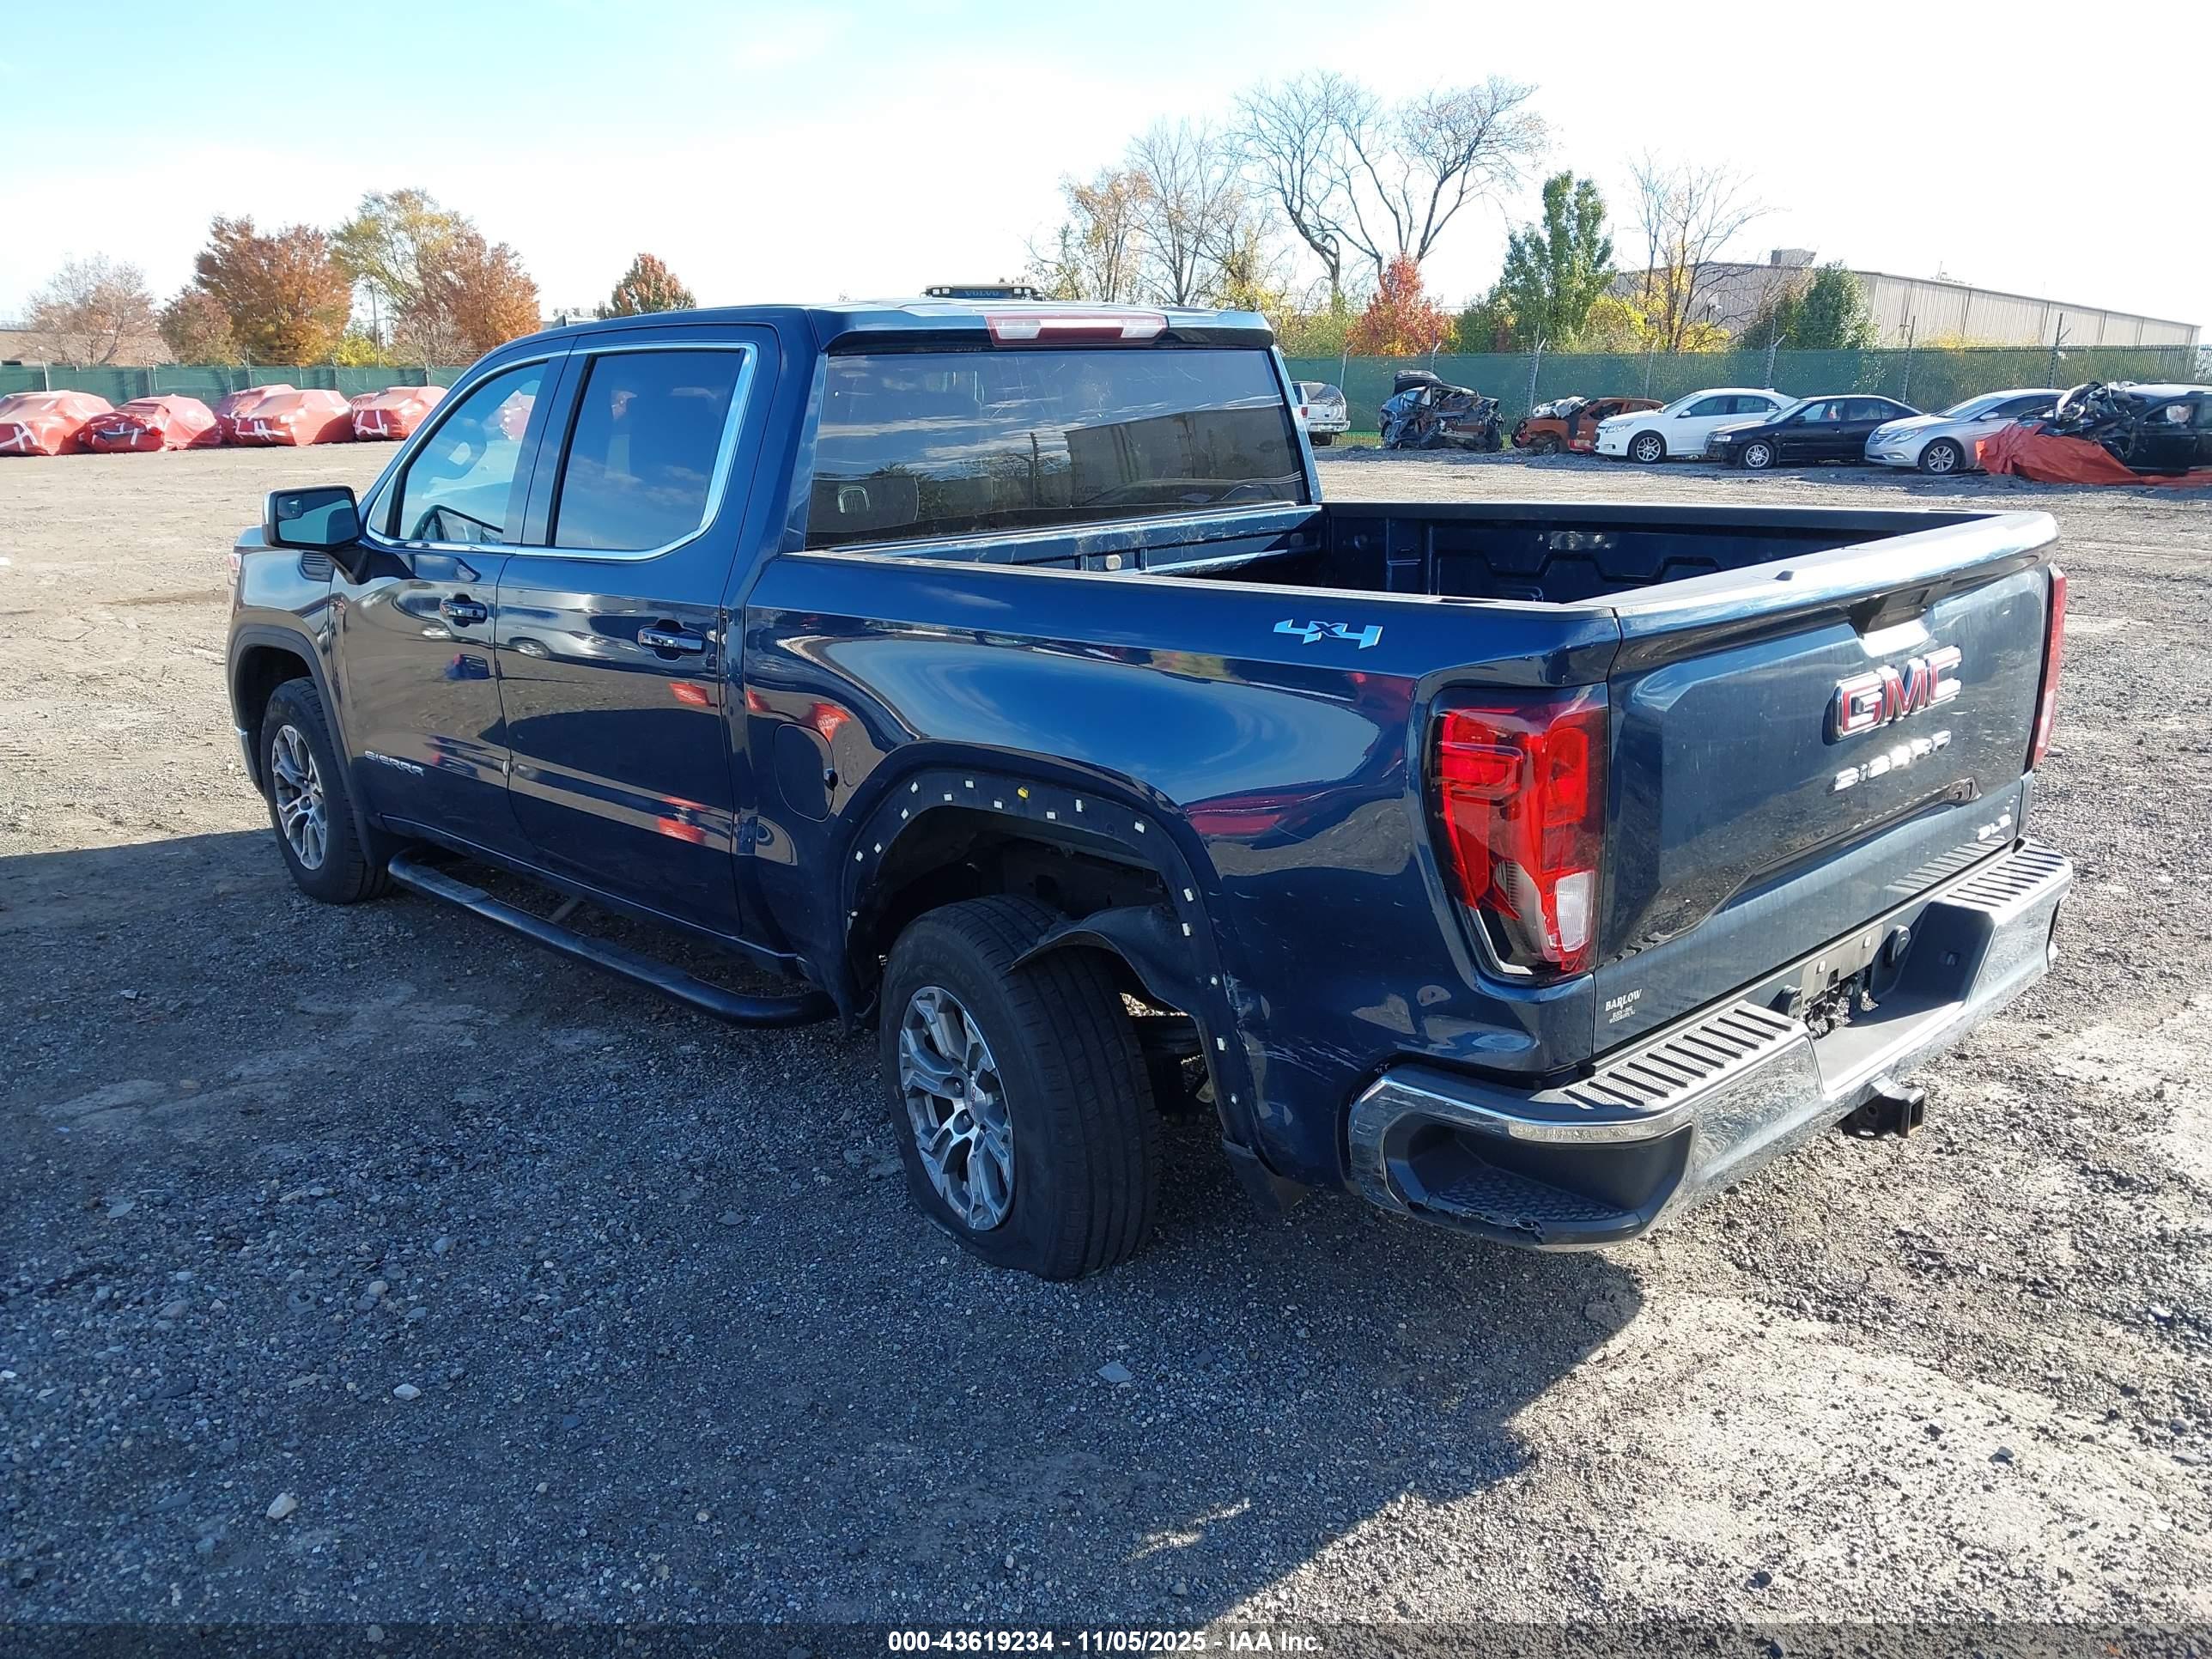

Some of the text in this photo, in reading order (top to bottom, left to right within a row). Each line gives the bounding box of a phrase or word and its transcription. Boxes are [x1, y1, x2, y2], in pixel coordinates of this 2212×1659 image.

[1833, 646, 1962, 740] GMC
[364, 750, 424, 776] SIERRA
[1605, 988, 1642, 1012] BARLOW
